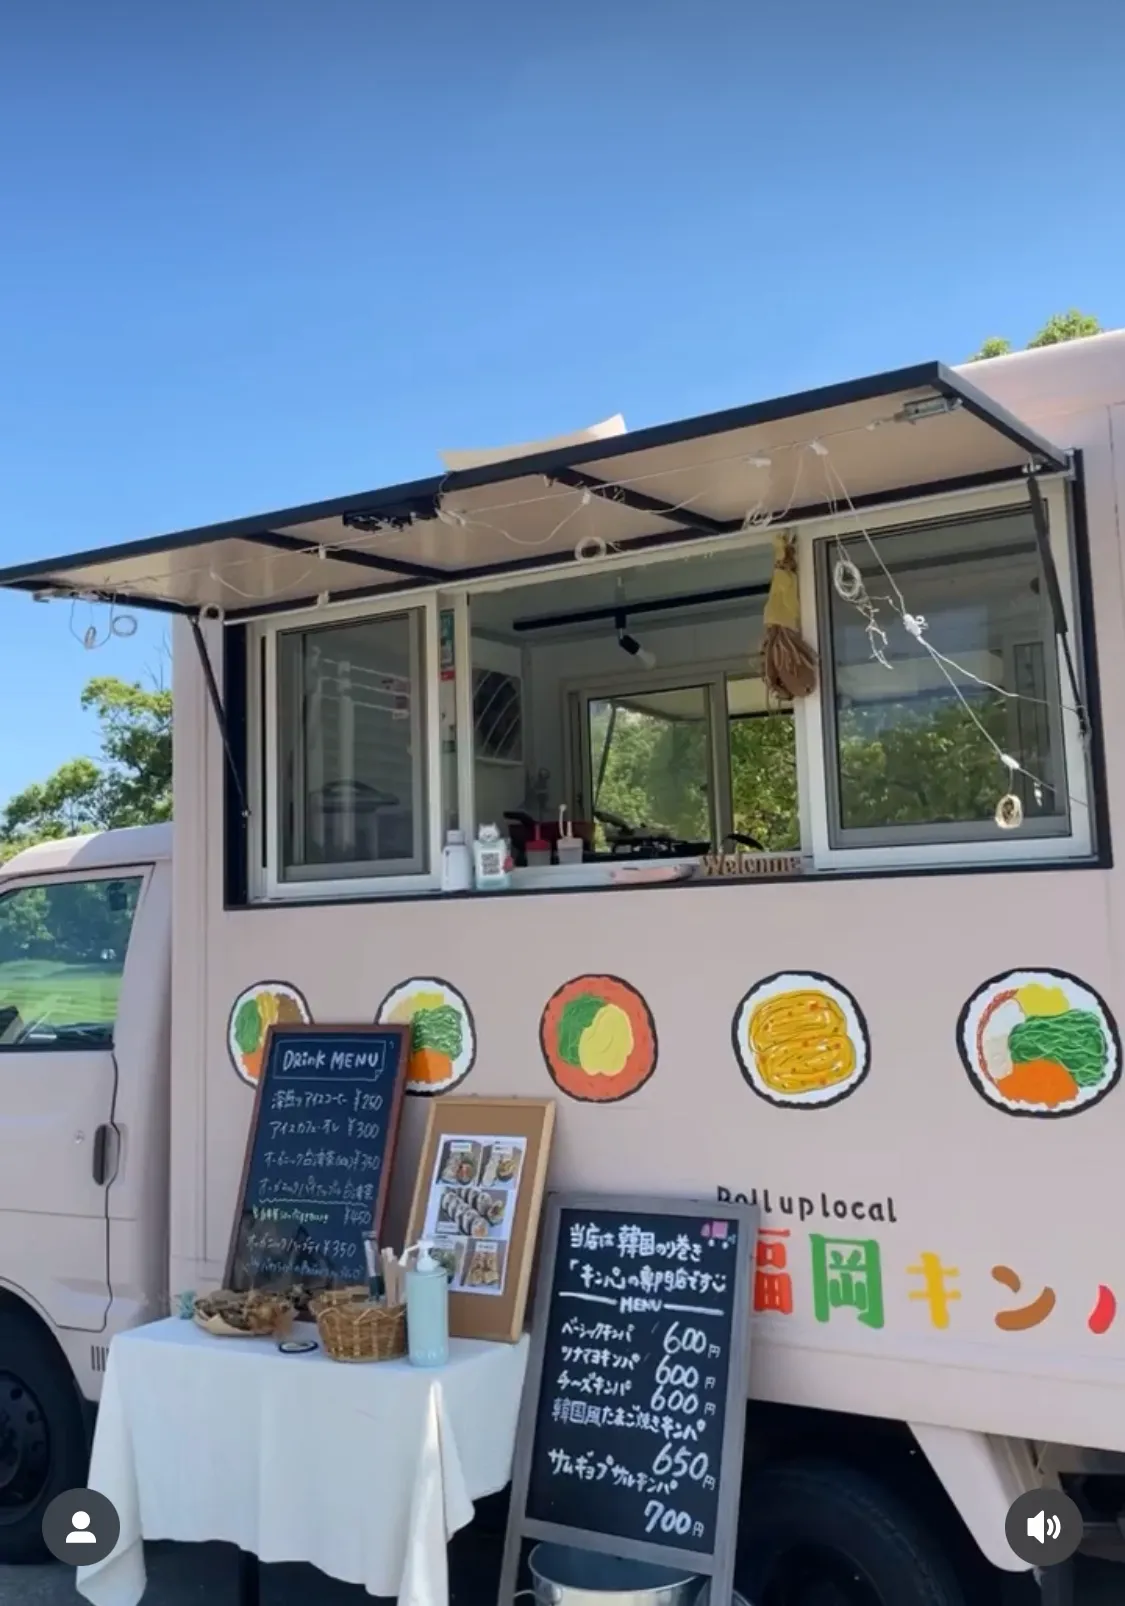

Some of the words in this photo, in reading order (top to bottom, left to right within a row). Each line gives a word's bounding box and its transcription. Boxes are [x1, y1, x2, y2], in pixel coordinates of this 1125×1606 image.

[330, 1051, 379, 1071] MENU
[346, 1116, 380, 1139] ¥300
[323, 1239, 357, 1258] ¥350
[619, 1297, 662, 1313] MENU
[556, 1369, 633, 1397] チーズキンパ
